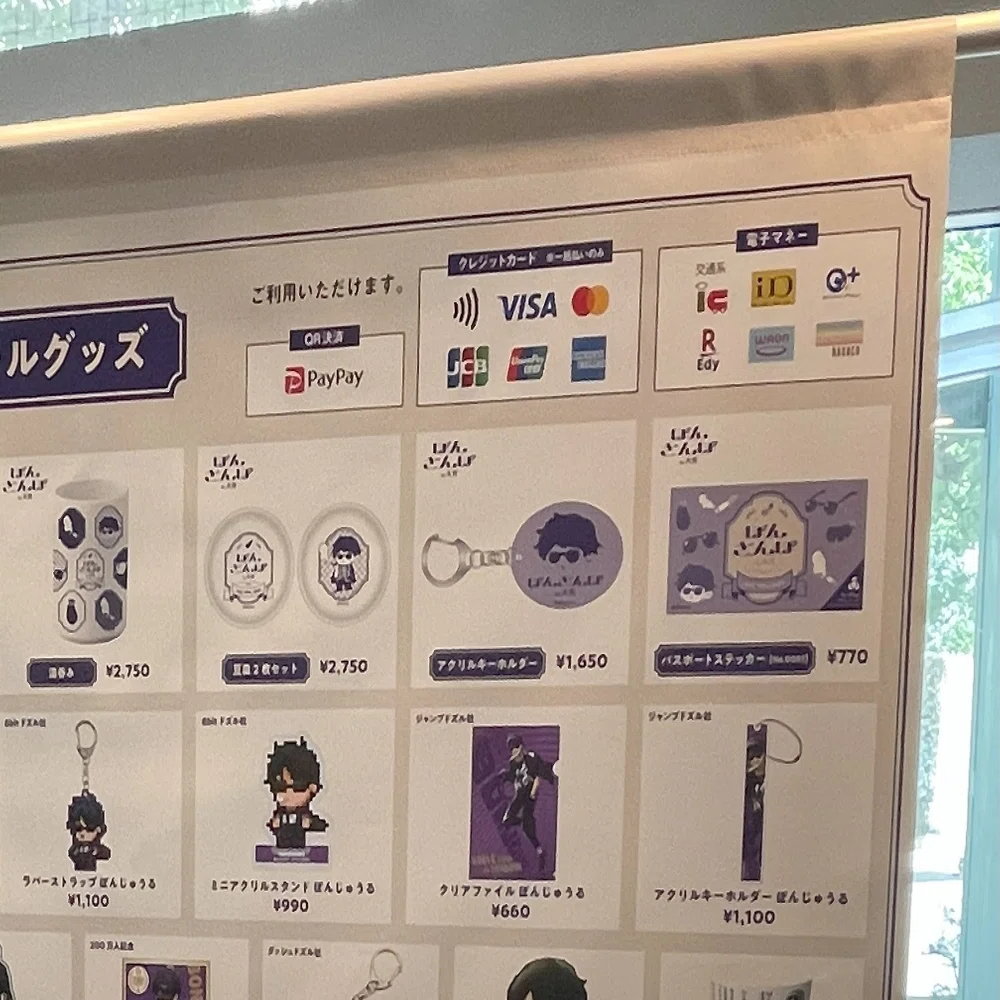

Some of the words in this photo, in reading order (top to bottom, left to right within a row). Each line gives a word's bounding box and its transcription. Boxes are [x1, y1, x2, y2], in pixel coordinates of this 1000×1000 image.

[746, 231, 808, 247] 電子マネー
[458, 251, 538, 271] クレジットカード
[251, 273, 403, 304] ご利用いただけます。
[498, 292, 557, 321] VISA
[307, 368, 364, 389] PayPay
[437, 656, 538, 671] アクリルキーホルダー
[556, 653, 608, 671] ¥1,650
[661, 652, 766, 666] パスポートステッカー
[827, 649, 868, 664] ¥770
[106, 664, 150, 679] ¥2,750
[320, 659, 368, 675] ¥2,750
[68, 894, 110, 908] ¥1,100
[273, 899, 309, 912] ¥990
[491, 904, 530, 918] ¥660
[723, 909, 776, 926] ¥1,100
